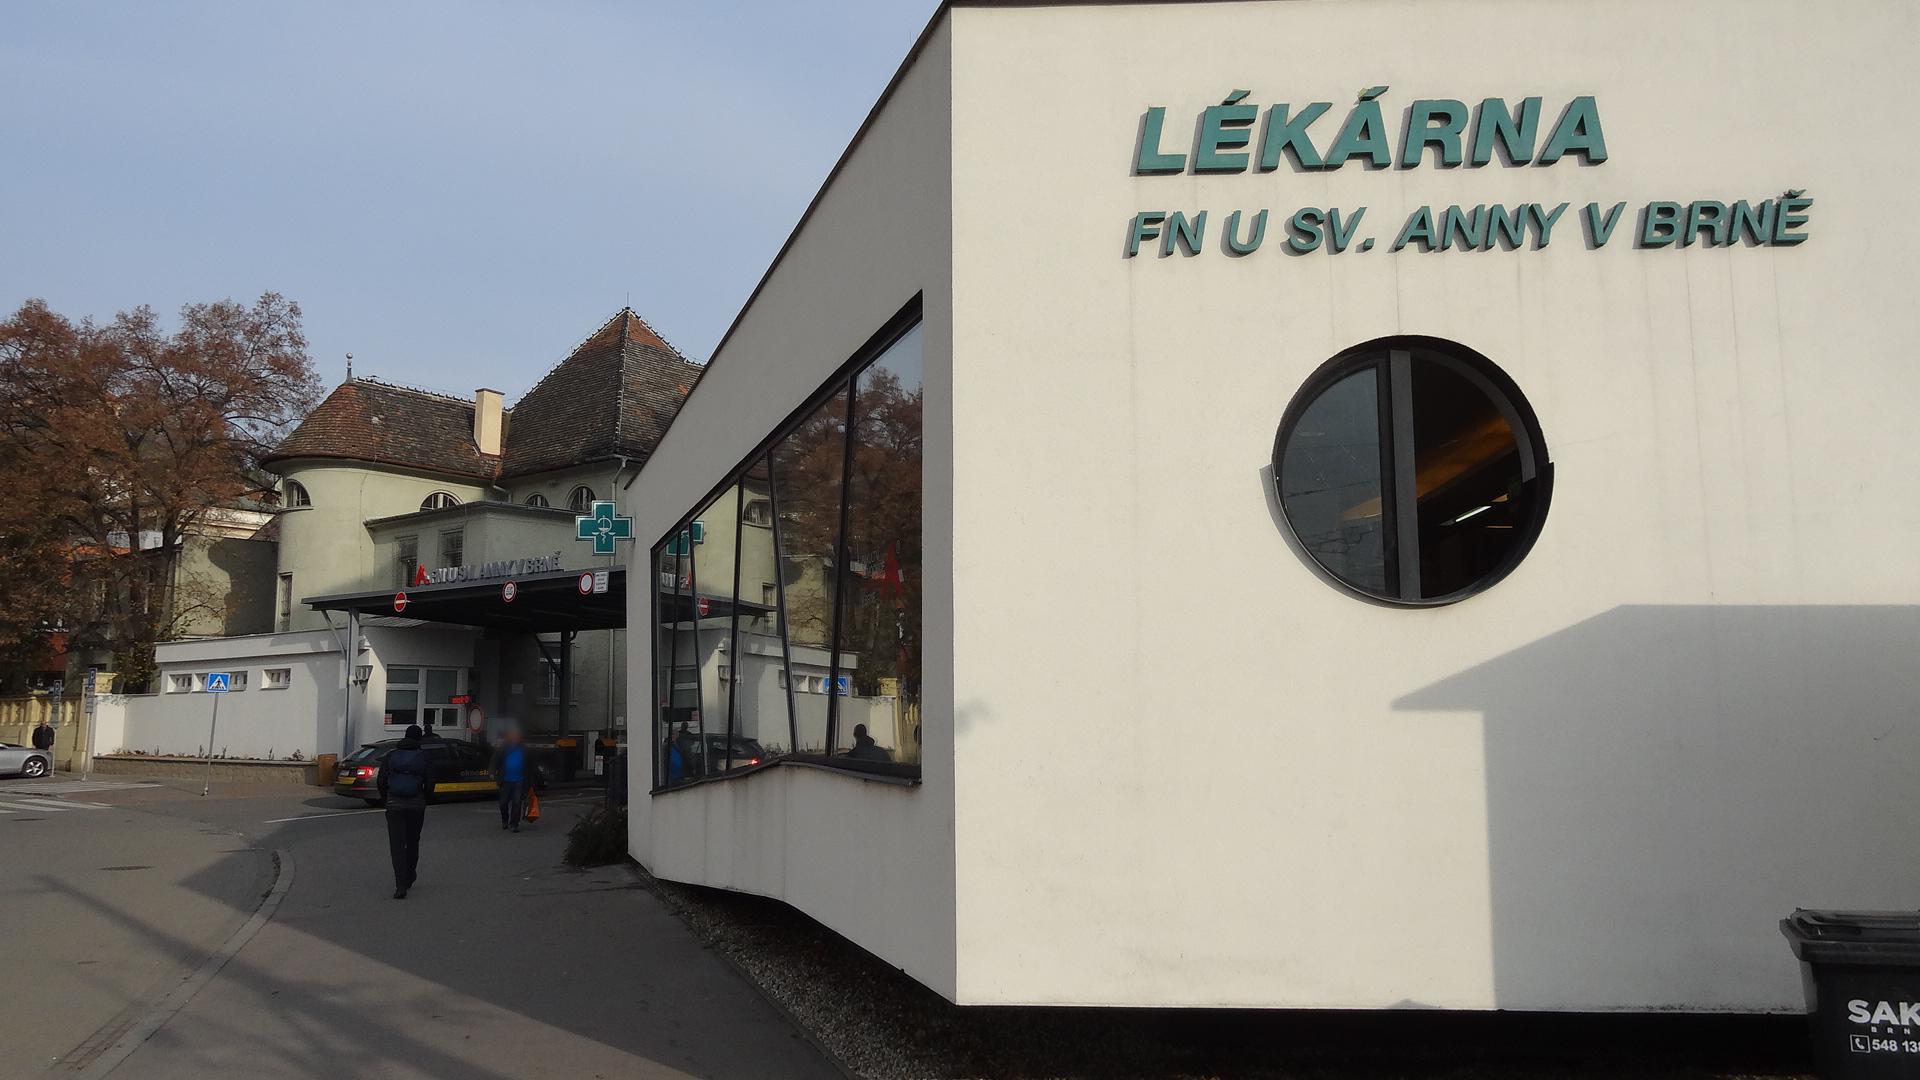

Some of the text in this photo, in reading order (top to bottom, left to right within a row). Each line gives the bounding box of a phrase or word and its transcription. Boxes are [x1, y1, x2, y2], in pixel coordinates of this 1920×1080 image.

[1135, 86, 1608, 174] LÉKÁRNA
[1128, 189, 1813, 257] FN U SV. ANNY V BRNĚ
[1872, 1039, 1920, 1053] 548 13
